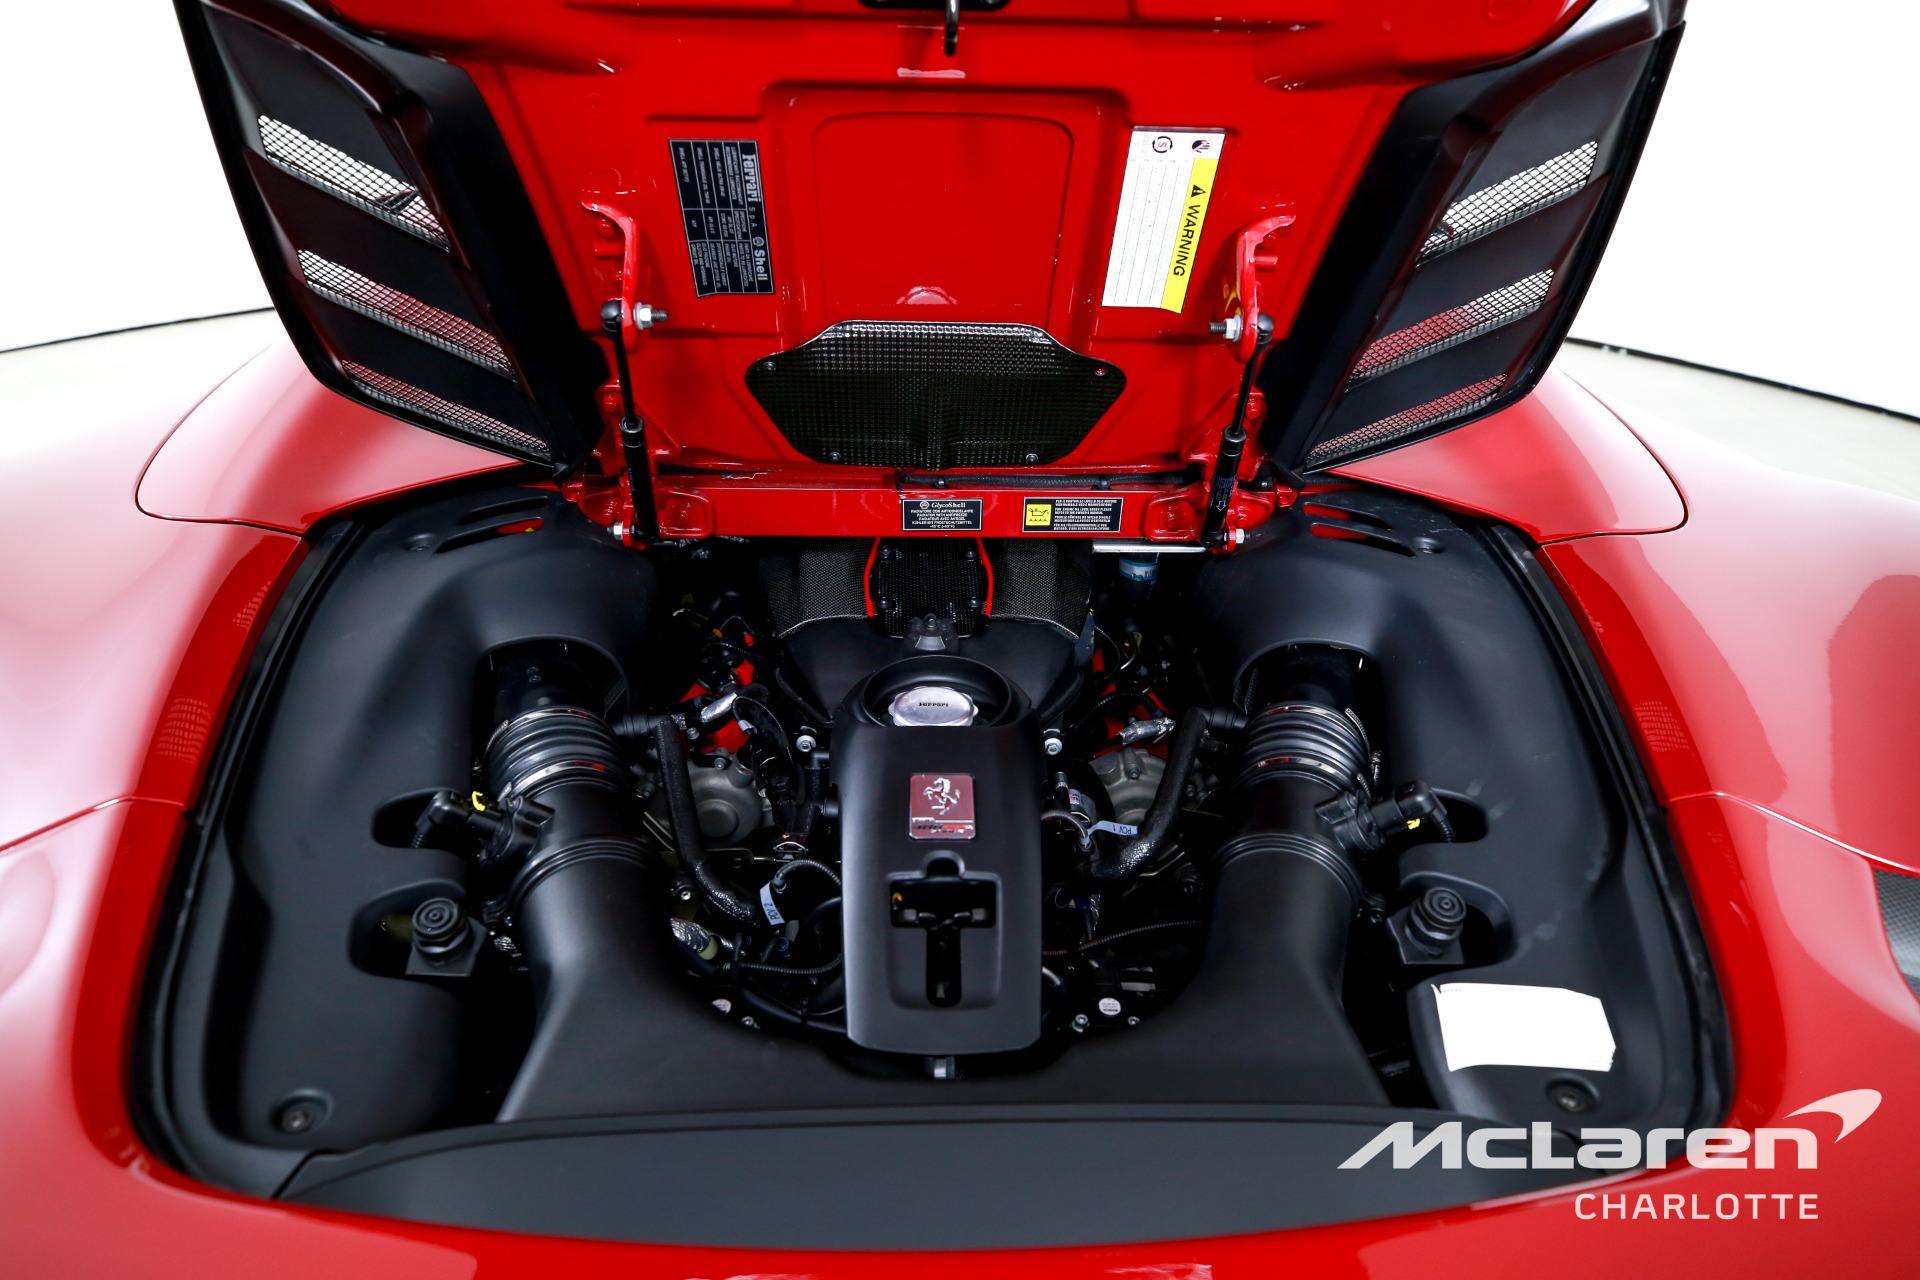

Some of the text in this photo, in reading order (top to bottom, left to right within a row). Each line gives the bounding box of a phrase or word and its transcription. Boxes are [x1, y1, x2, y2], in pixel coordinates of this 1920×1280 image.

[742, 154, 761, 202] Ferrari
[1173, 204, 1201, 277] WARNING
[754, 250, 768, 280] Shell
[1119, 826, 1131, 834] PCV
